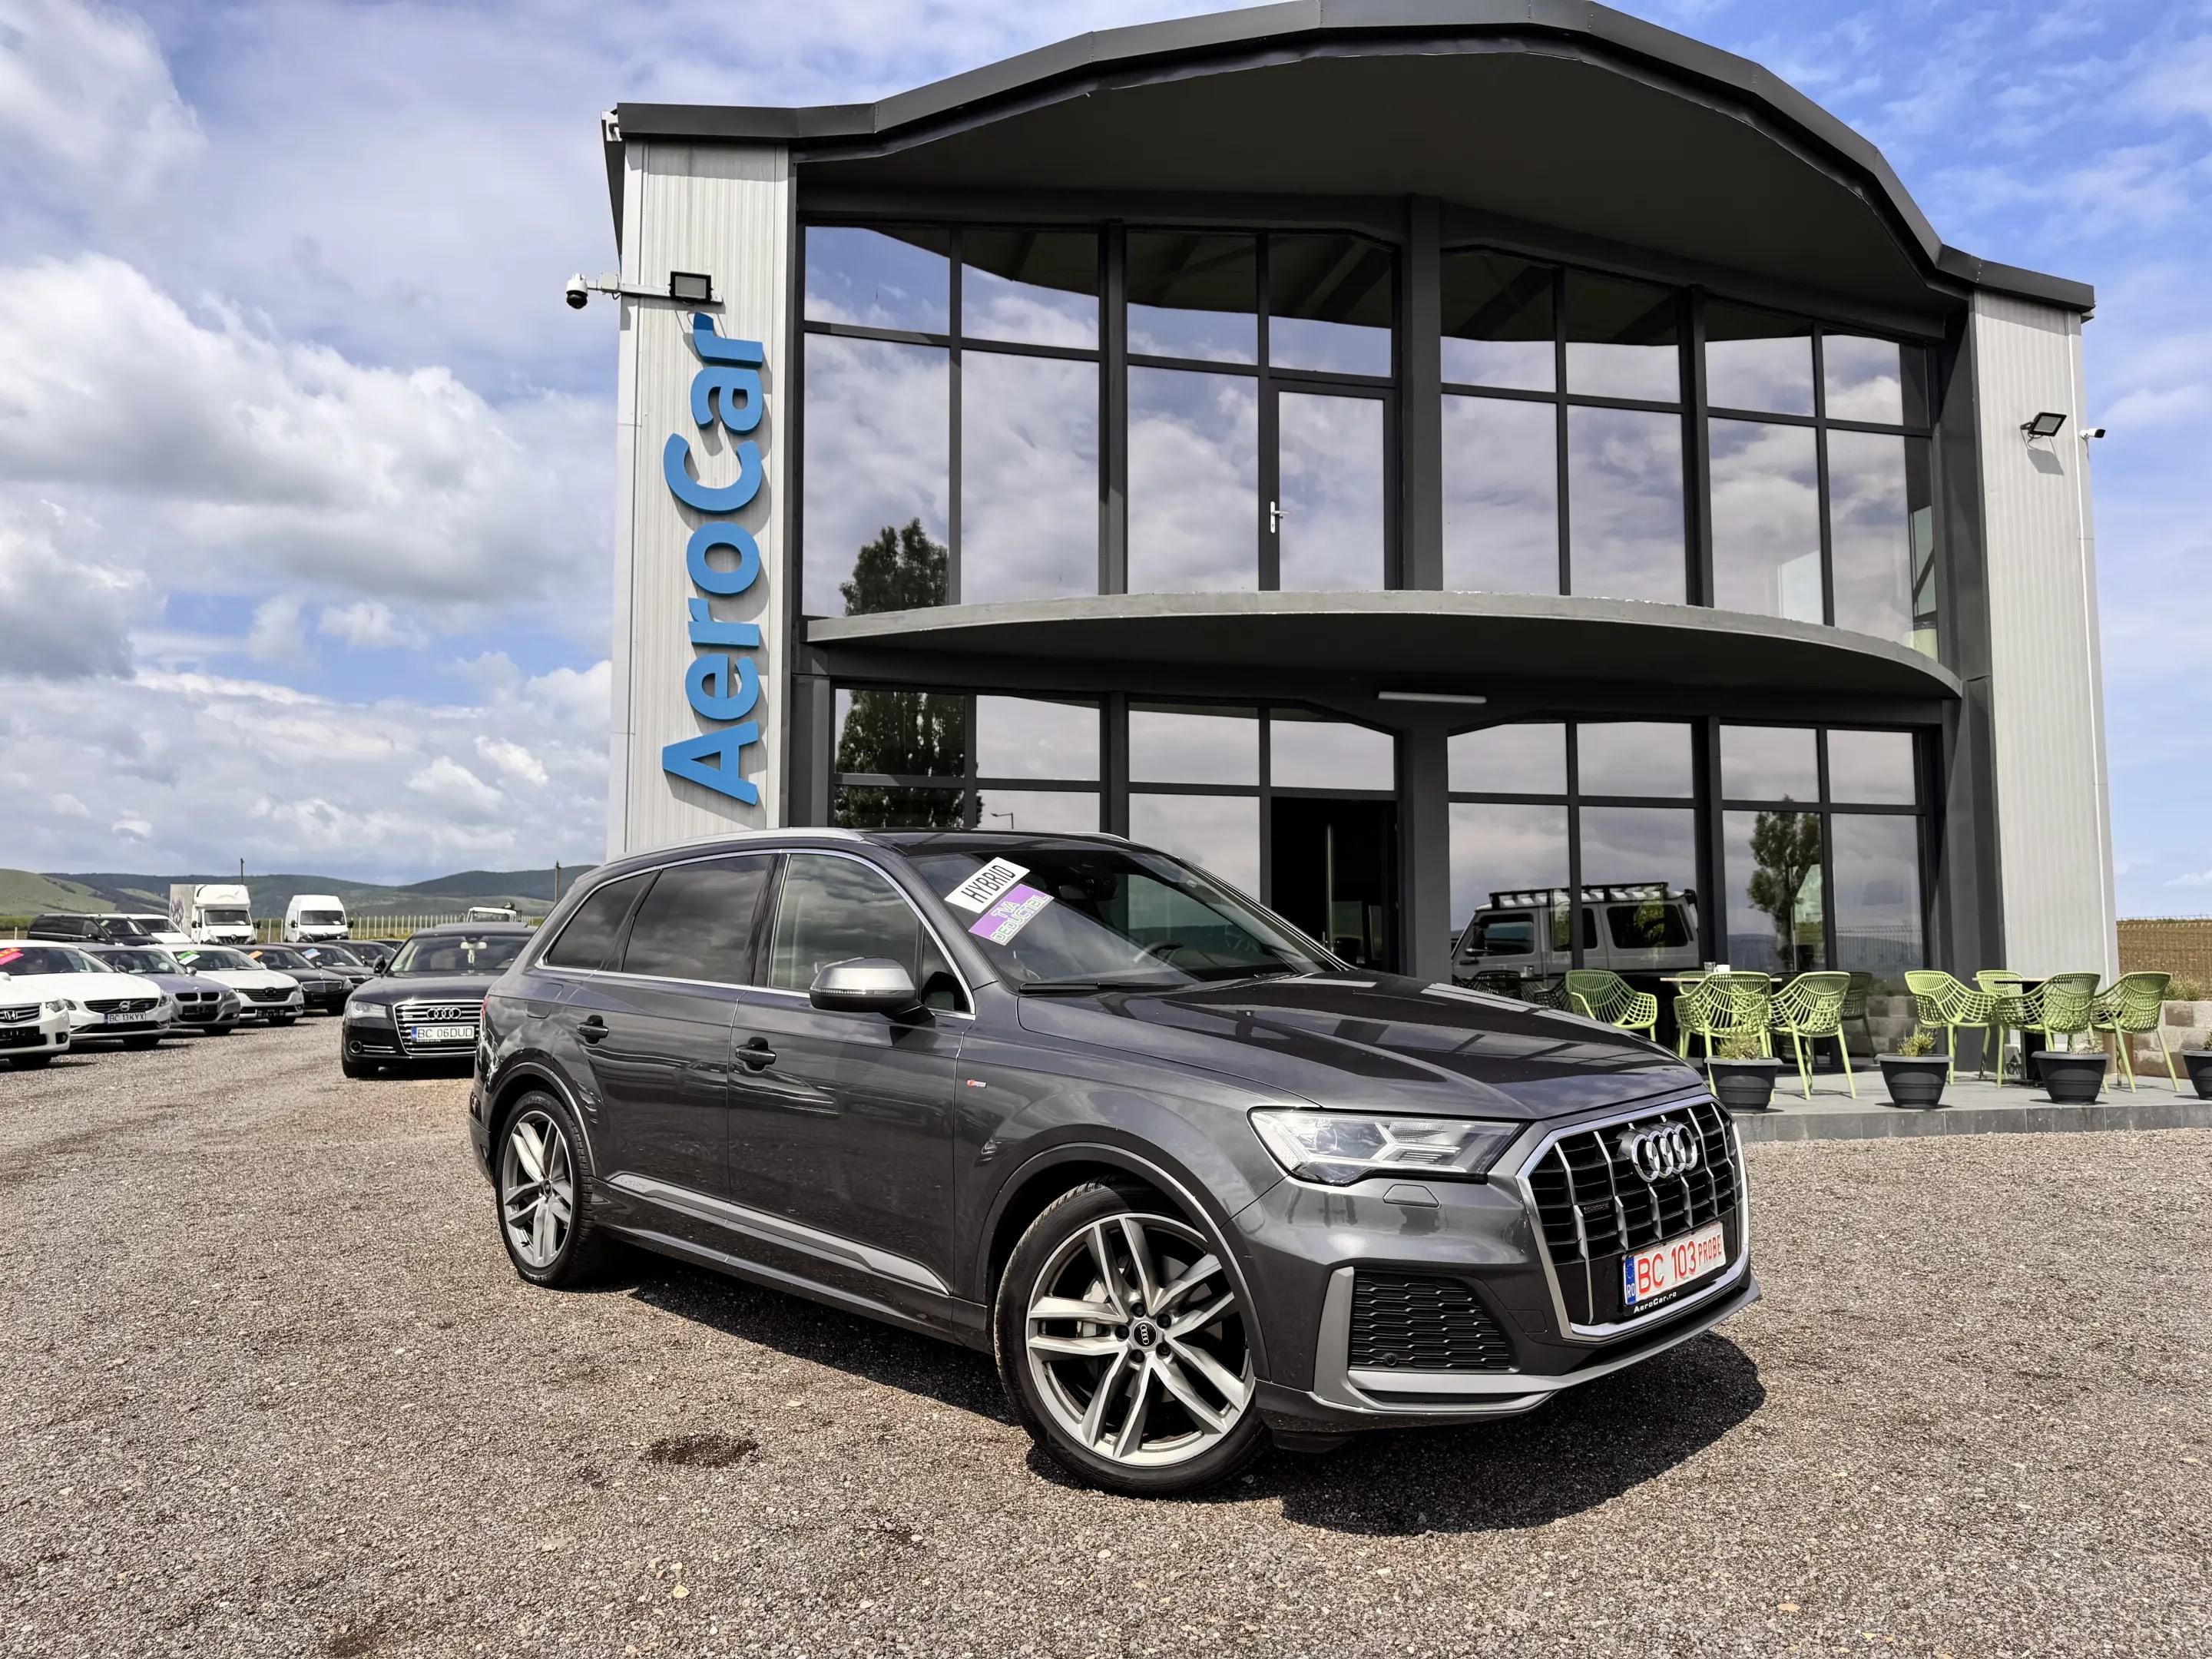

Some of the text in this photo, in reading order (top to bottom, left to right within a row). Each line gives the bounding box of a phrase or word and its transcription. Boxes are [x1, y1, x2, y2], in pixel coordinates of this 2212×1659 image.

[662, 312, 763, 806] AeroCar
[961, 865, 1016, 904] HYBRID
[990, 895, 1050, 942] DEDUCTIBIL
[991, 900, 1020, 919] TVA
[418, 1028, 432, 1038] BC
[1626, 1283, 1636, 1298] RO
[1637, 1253, 1664, 1294] BC
